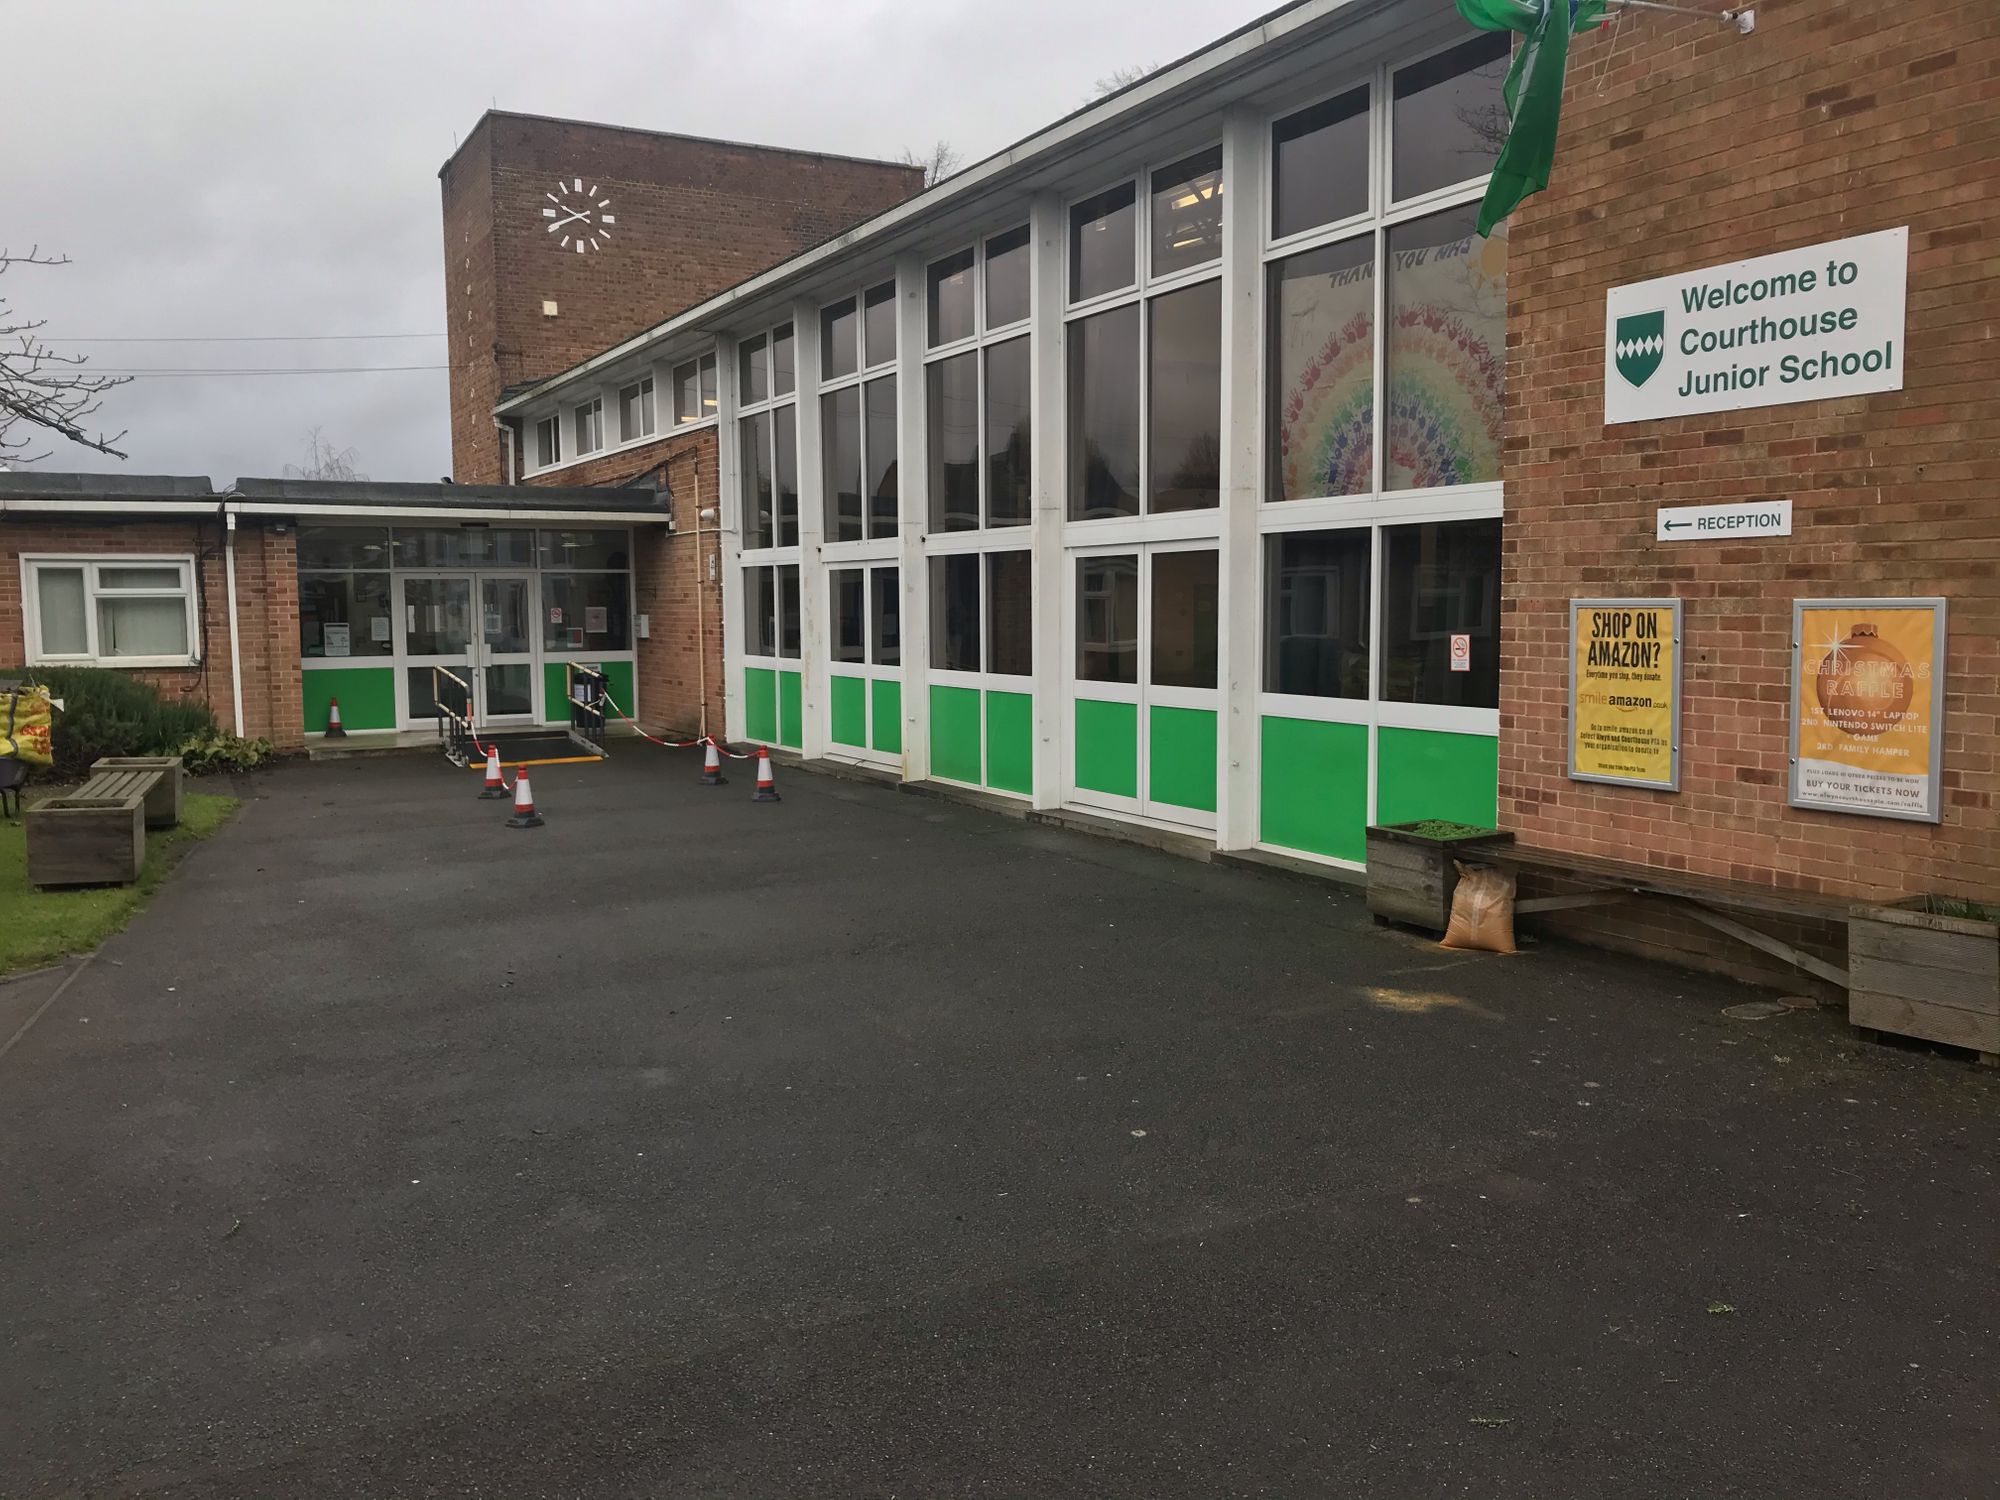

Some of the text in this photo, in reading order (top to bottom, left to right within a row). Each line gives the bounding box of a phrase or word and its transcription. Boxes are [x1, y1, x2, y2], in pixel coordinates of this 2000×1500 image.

[1329, 262, 1375, 288] THAN
[1395, 249, 1429, 271] YOU
[1681, 260, 1858, 314] Welcome to
[1680, 307, 1858, 355] Courthouse
[1678, 341, 1892, 397] Junior School
[1697, 513, 1781, 530] RECEPTION
[1592, 612, 1657, 639] SHOP ON
[1587, 641, 1661, 668] AMAZON?
[1803, 659, 1930, 679] CHRISTMAS
[1579, 692, 1607, 705] smile
[1826, 680, 1904, 699] RAFFLE
[1811, 707, 1919, 721] 1ST LENOVO 14" LAPTOP
[1823, 720, 1868, 730] NINTENDO
[1870, 722, 1905, 733] SWITCH
[1908, 725, 1927, 734] LITE
[1853, 733, 1879, 742] GAME
[1839, 743, 1869, 754] FAMILY
[1872, 746, 1910, 757] HAMPER
[1806, 779, 1920, 798] BUY YOUR TICKETS NOW
